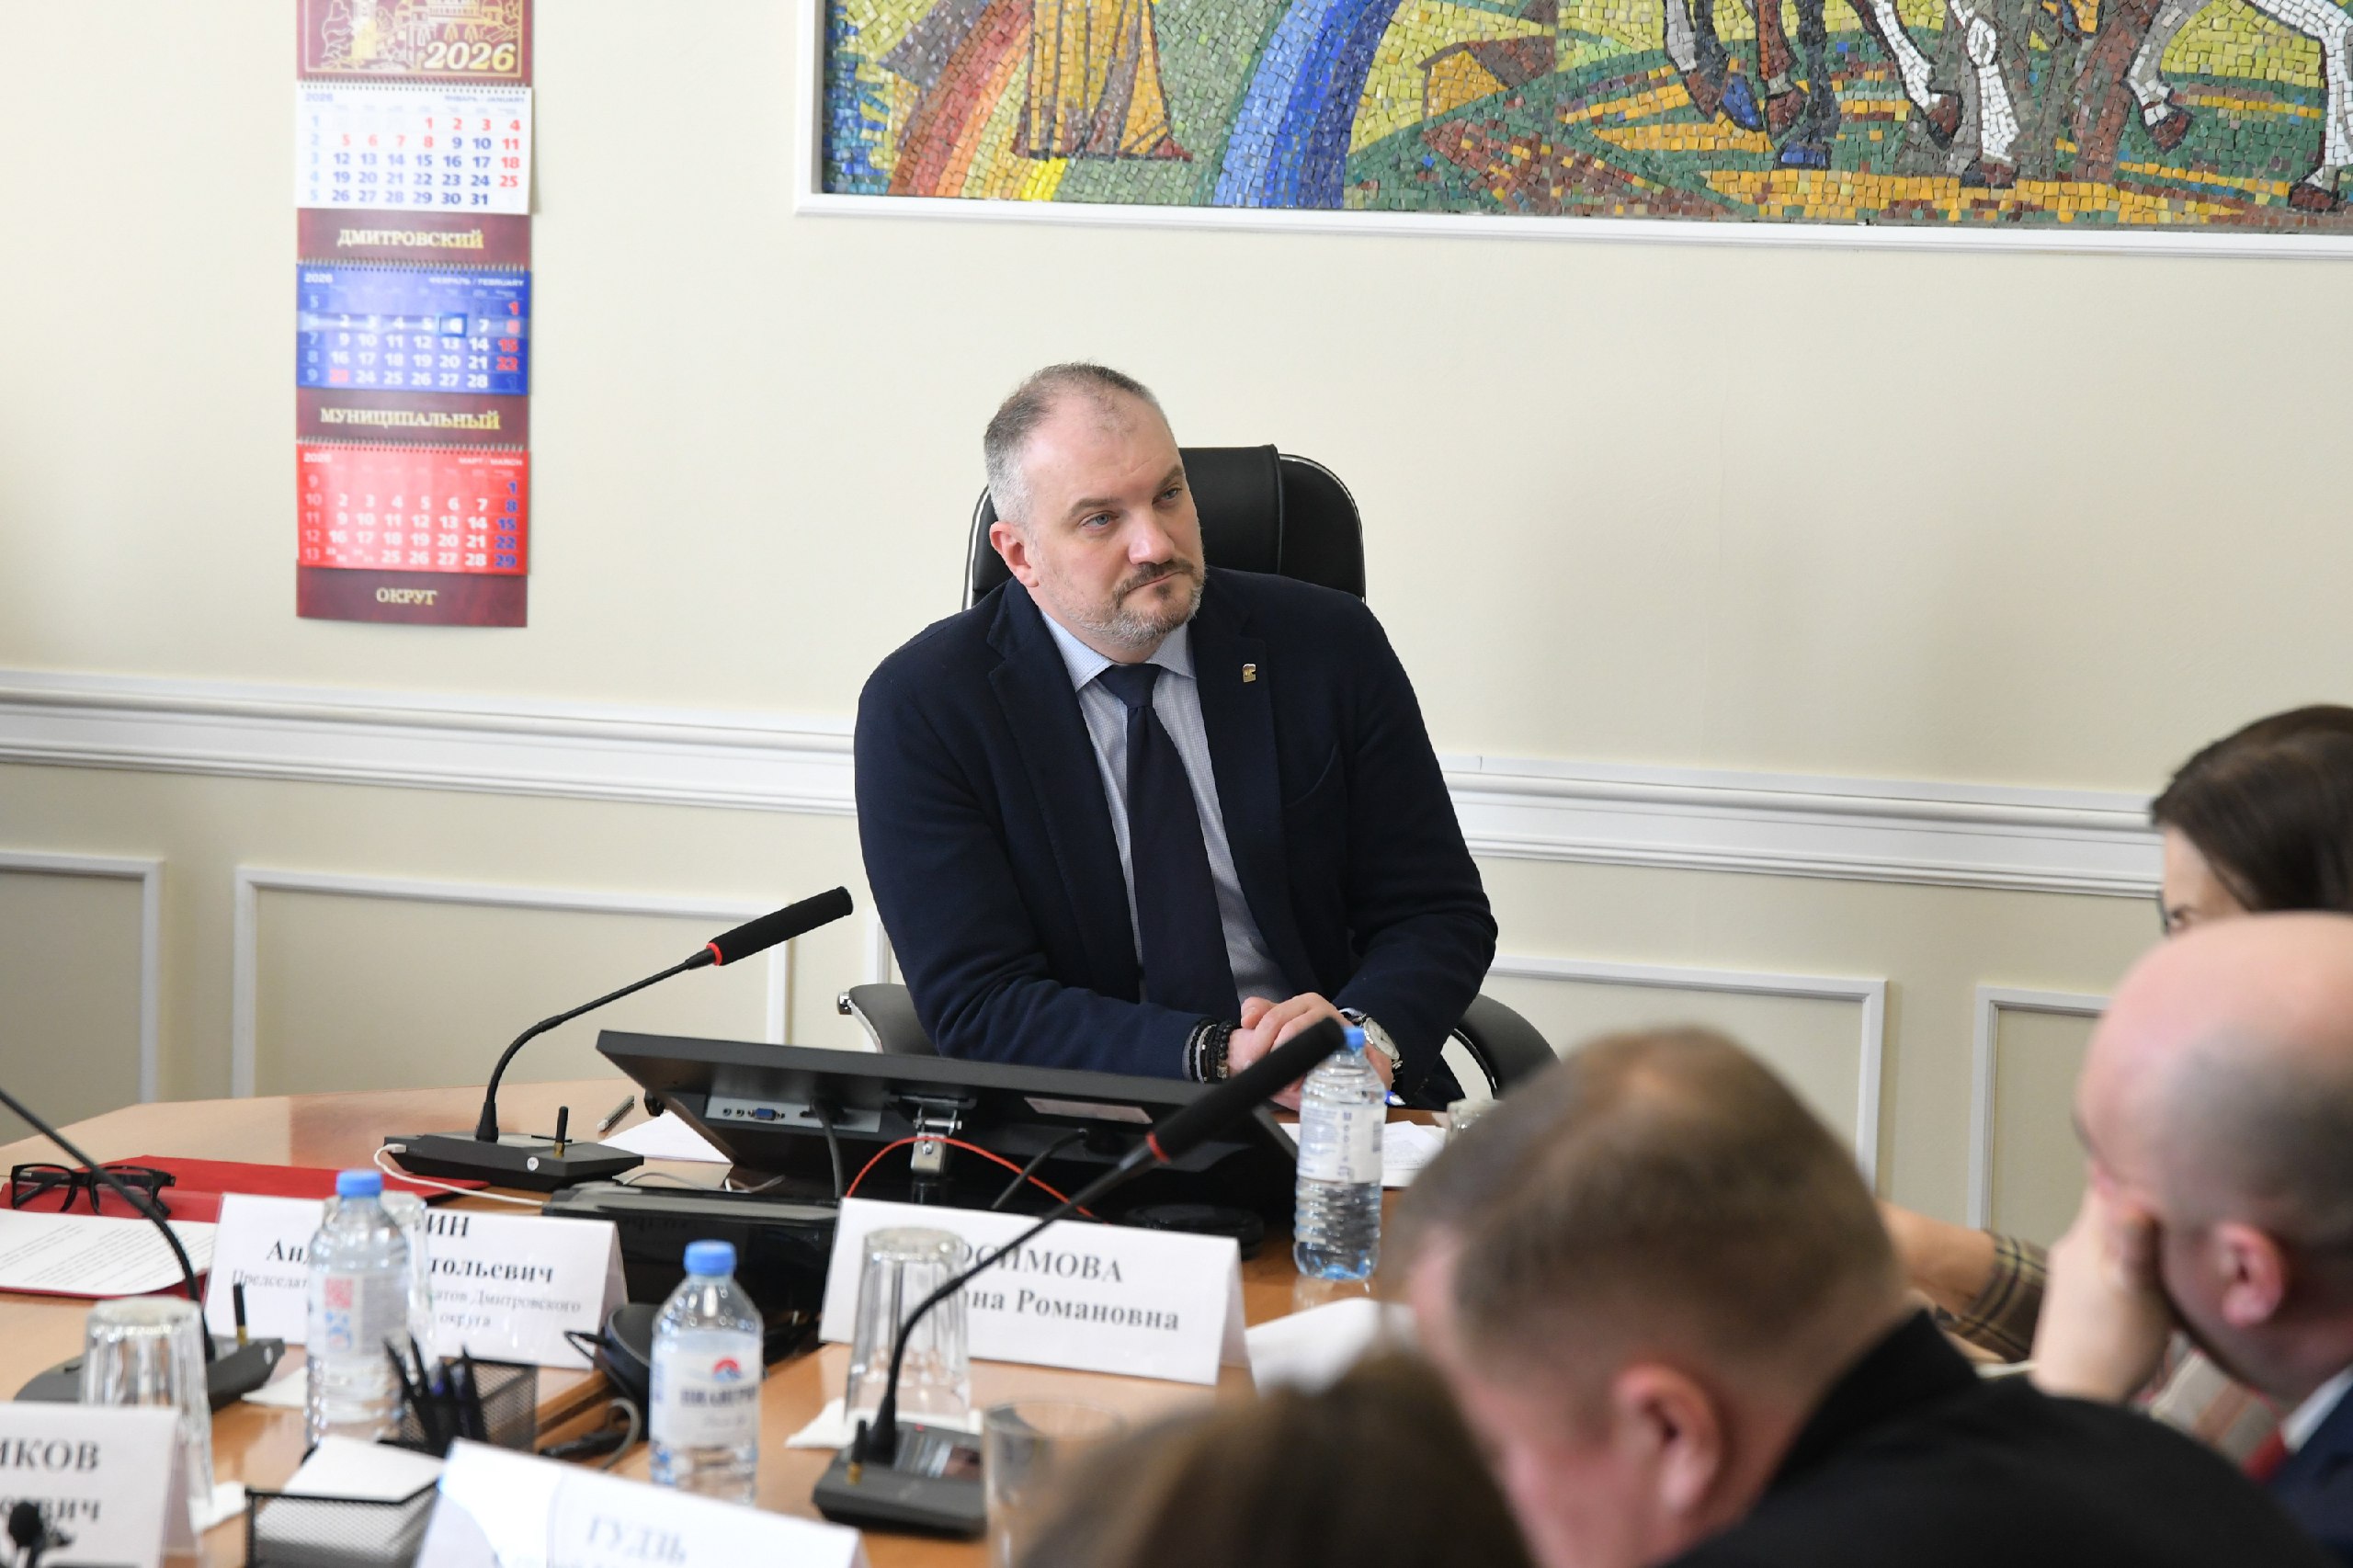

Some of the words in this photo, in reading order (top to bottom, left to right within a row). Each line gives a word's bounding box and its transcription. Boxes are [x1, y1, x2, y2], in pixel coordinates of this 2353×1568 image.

[425, 41, 515, 71] 2026
[426, 118, 432, 129] 1
[454, 118, 462, 131] 2
[483, 119, 491, 131] 3
[510, 119, 520, 131] 4
[343, 134, 350, 146] 5
[368, 134, 378, 146] 6
[397, 135, 405, 147] 7
[424, 136, 433, 148] 8
[452, 137, 462, 149] 9
[473, 138, 491, 150] 10
[503, 138, 518, 150] 11
[334, 153, 350, 165] 12
[361, 153, 377, 165] 13
[388, 154, 404, 165] 14
[416, 154, 432, 166] 15
[444, 155, 461, 167] 16
[472, 156, 490, 167] 17
[502, 157, 519, 168] 18
[334, 171, 350, 183] 19
[358, 172, 378, 184] 20
[387, 172, 404, 185] 21
[415, 173, 432, 186] 22
[443, 174, 460, 186] 23
[472, 175, 490, 187] 24
[500, 176, 517, 187] 25
[332, 189, 350, 201] 26
[358, 190, 376, 202] 27
[385, 190, 404, 203] 28
[415, 192, 432, 203] 29
[442, 192, 461, 204] 30
[472, 193, 487, 205] 31
[337, 229, 483, 249] ДМИТРОВСКИЙ
[304, 274, 333, 284] 2026
[478, 278, 524, 287] FEBRUARY
[321, 407, 500, 429] МУНИЦИПАЛЬНЫЙ
[508, 482, 517, 494] 1
[338, 494, 348, 506] 2
[366, 494, 375, 507] 3
[392, 495, 403, 508] 4
[421, 495, 430, 510] 5
[449, 497, 460, 509] 6
[477, 498, 487, 511] 7
[506, 499, 517, 513] 8
[337, 512, 348, 525] 9
[356, 513, 376, 526] 10
[385, 514, 402, 527] 11
[412, 515, 429, 528] 12
[440, 516, 459, 529] 13
[468, 517, 487, 529] 14
[497, 517, 516, 531] 15
[330, 530, 348, 543] 16
[357, 530, 375, 544] 17
[383, 531, 402, 546] 18
[411, 532, 430, 546] 19
[438, 533, 459, 548] 20
[467, 535, 485, 548] 21
[495, 535, 517, 550] 22
[381, 550, 401, 563] 25
[409, 551, 429, 564] 26
[438, 551, 458, 566] 27
[465, 553, 486, 566] 28
[494, 553, 517, 568] 29
[376, 587, 438, 605] ОКРУГ
[415, 1214, 470, 1238] ИН
[470, 1289, 581, 1312] Дмитровского
[1016, 1289, 1179, 1331] Романовна
